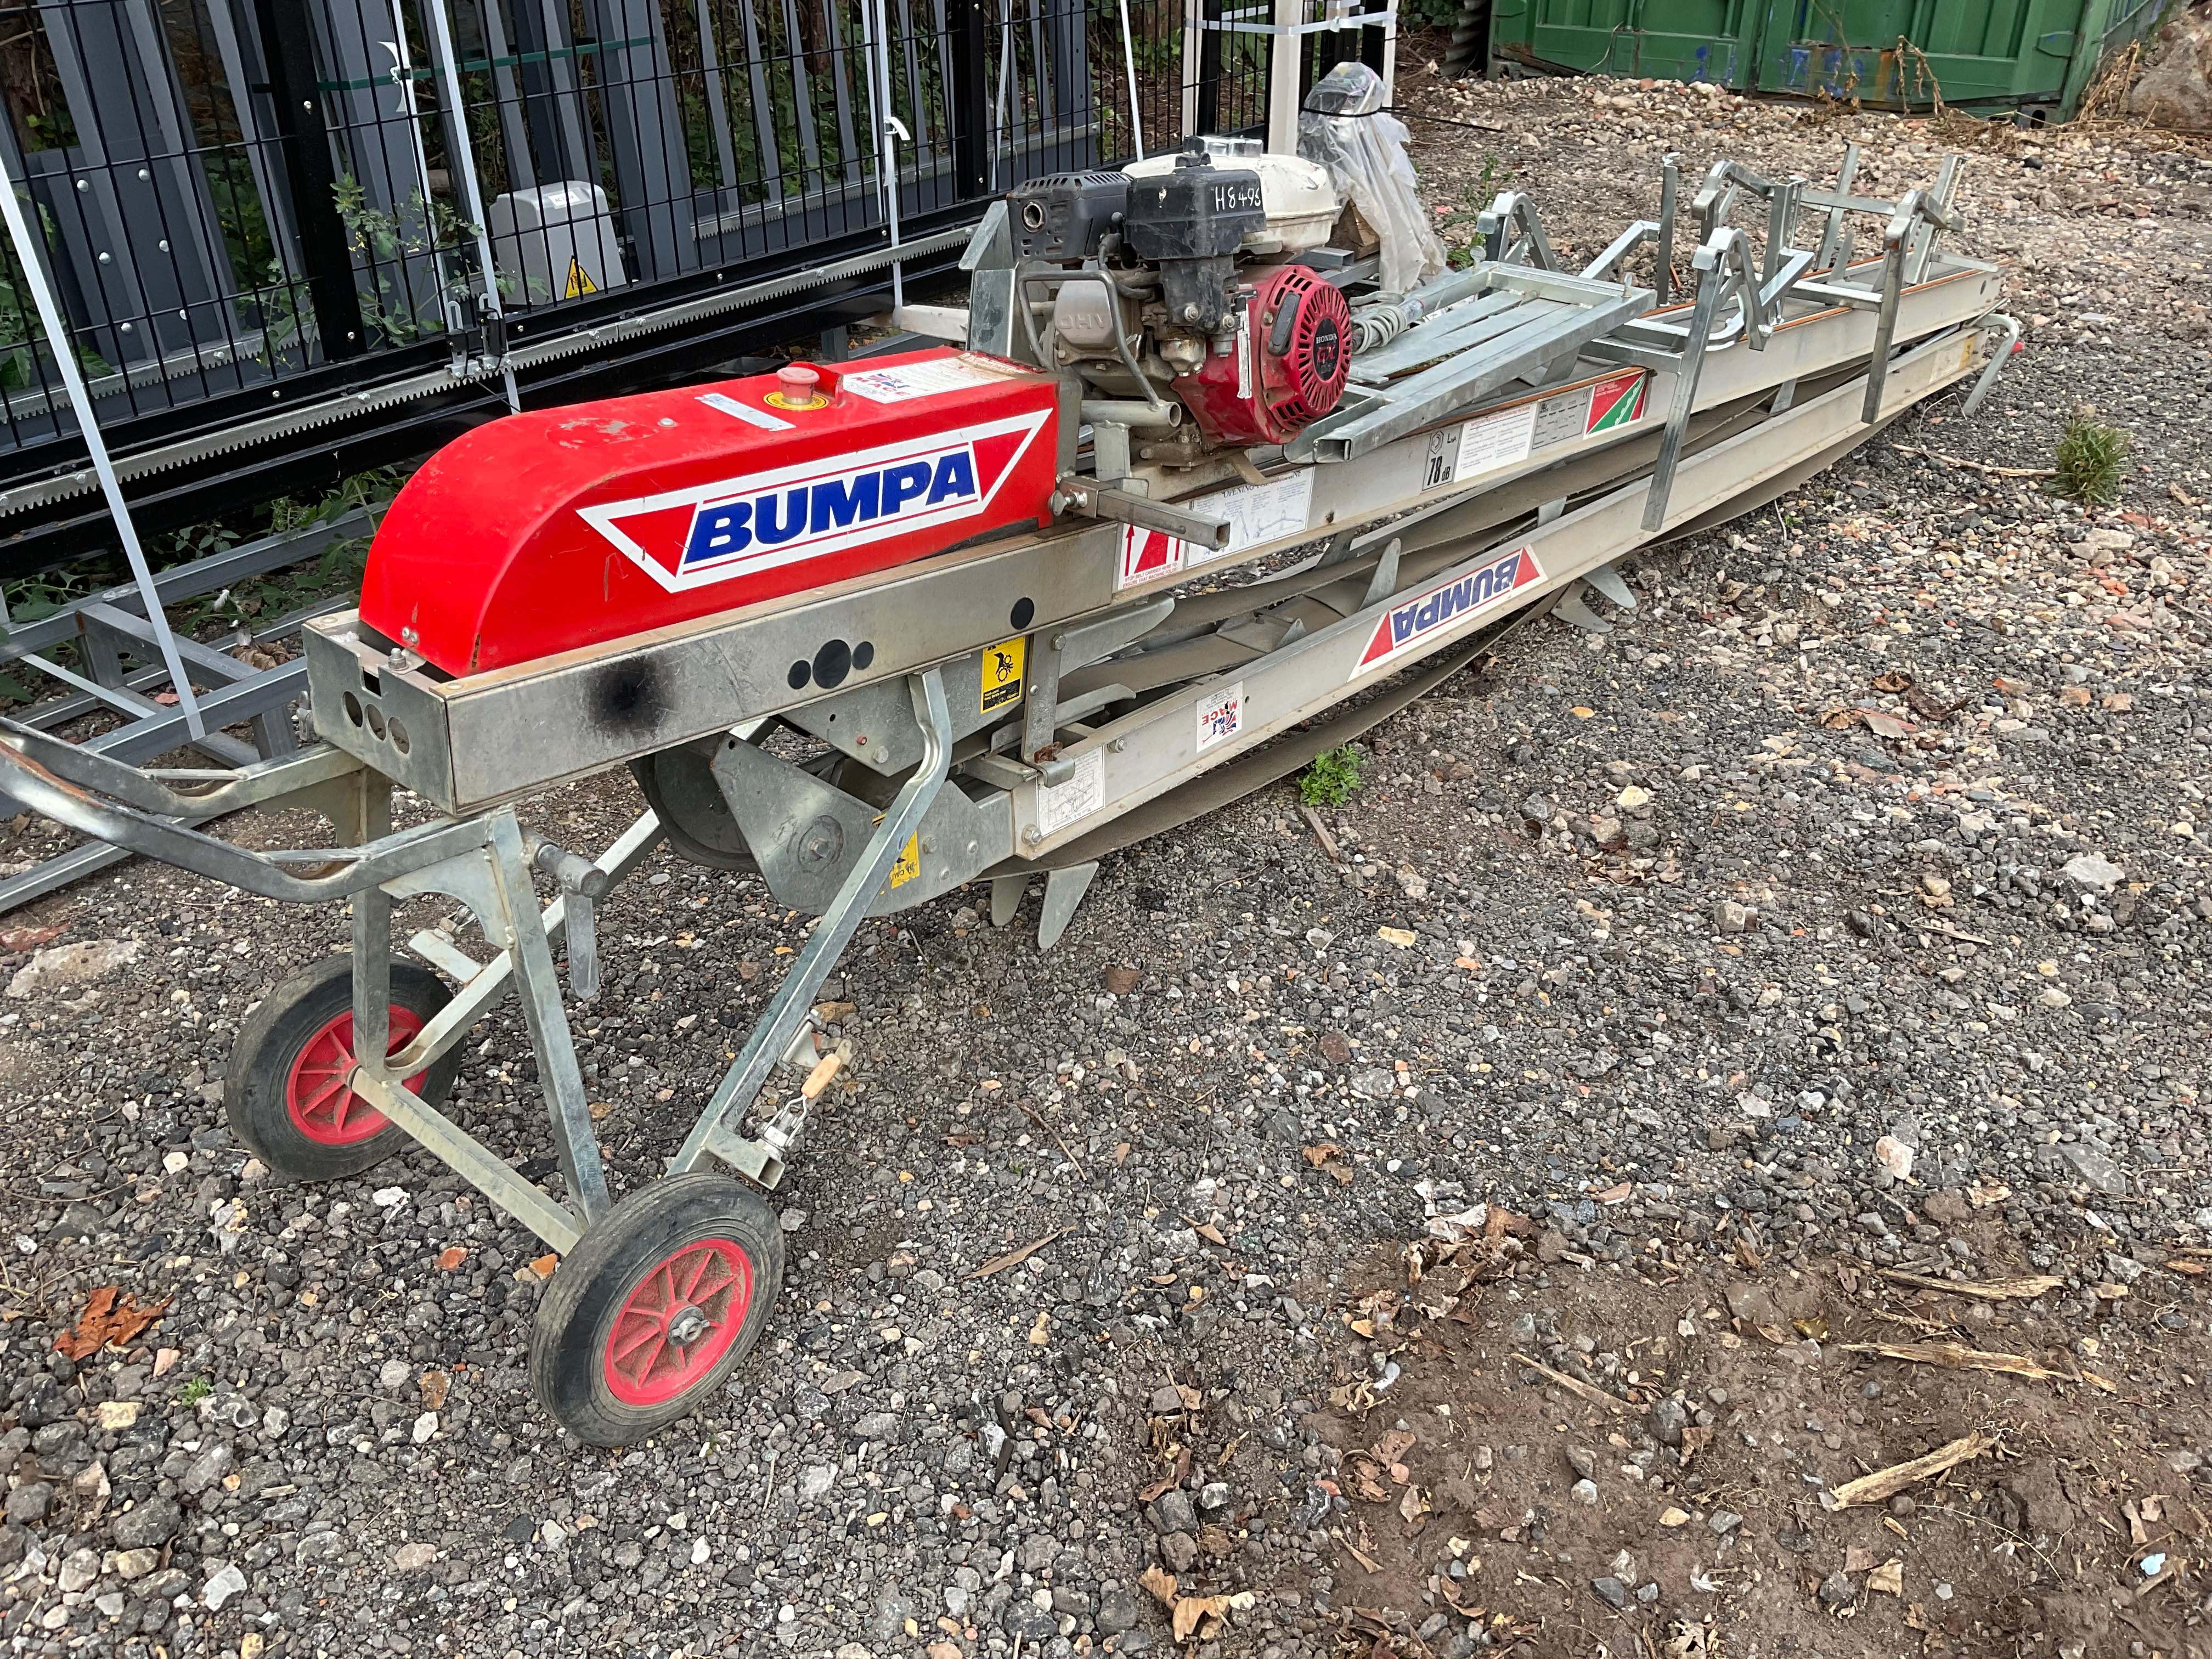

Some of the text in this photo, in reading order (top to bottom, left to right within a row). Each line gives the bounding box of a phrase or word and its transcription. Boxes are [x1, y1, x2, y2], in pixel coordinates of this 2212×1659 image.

[1059, 314, 1104, 329] OHV
[1316, 334, 1338, 344] HONDA
[851, 377, 911, 396] MACE
[1427, 456, 1451, 486] 78 dB
[684, 451, 975, 565] BUMPA
[1392, 555, 1520, 642] BUMPA
[1202, 699, 1238, 726] MACE
